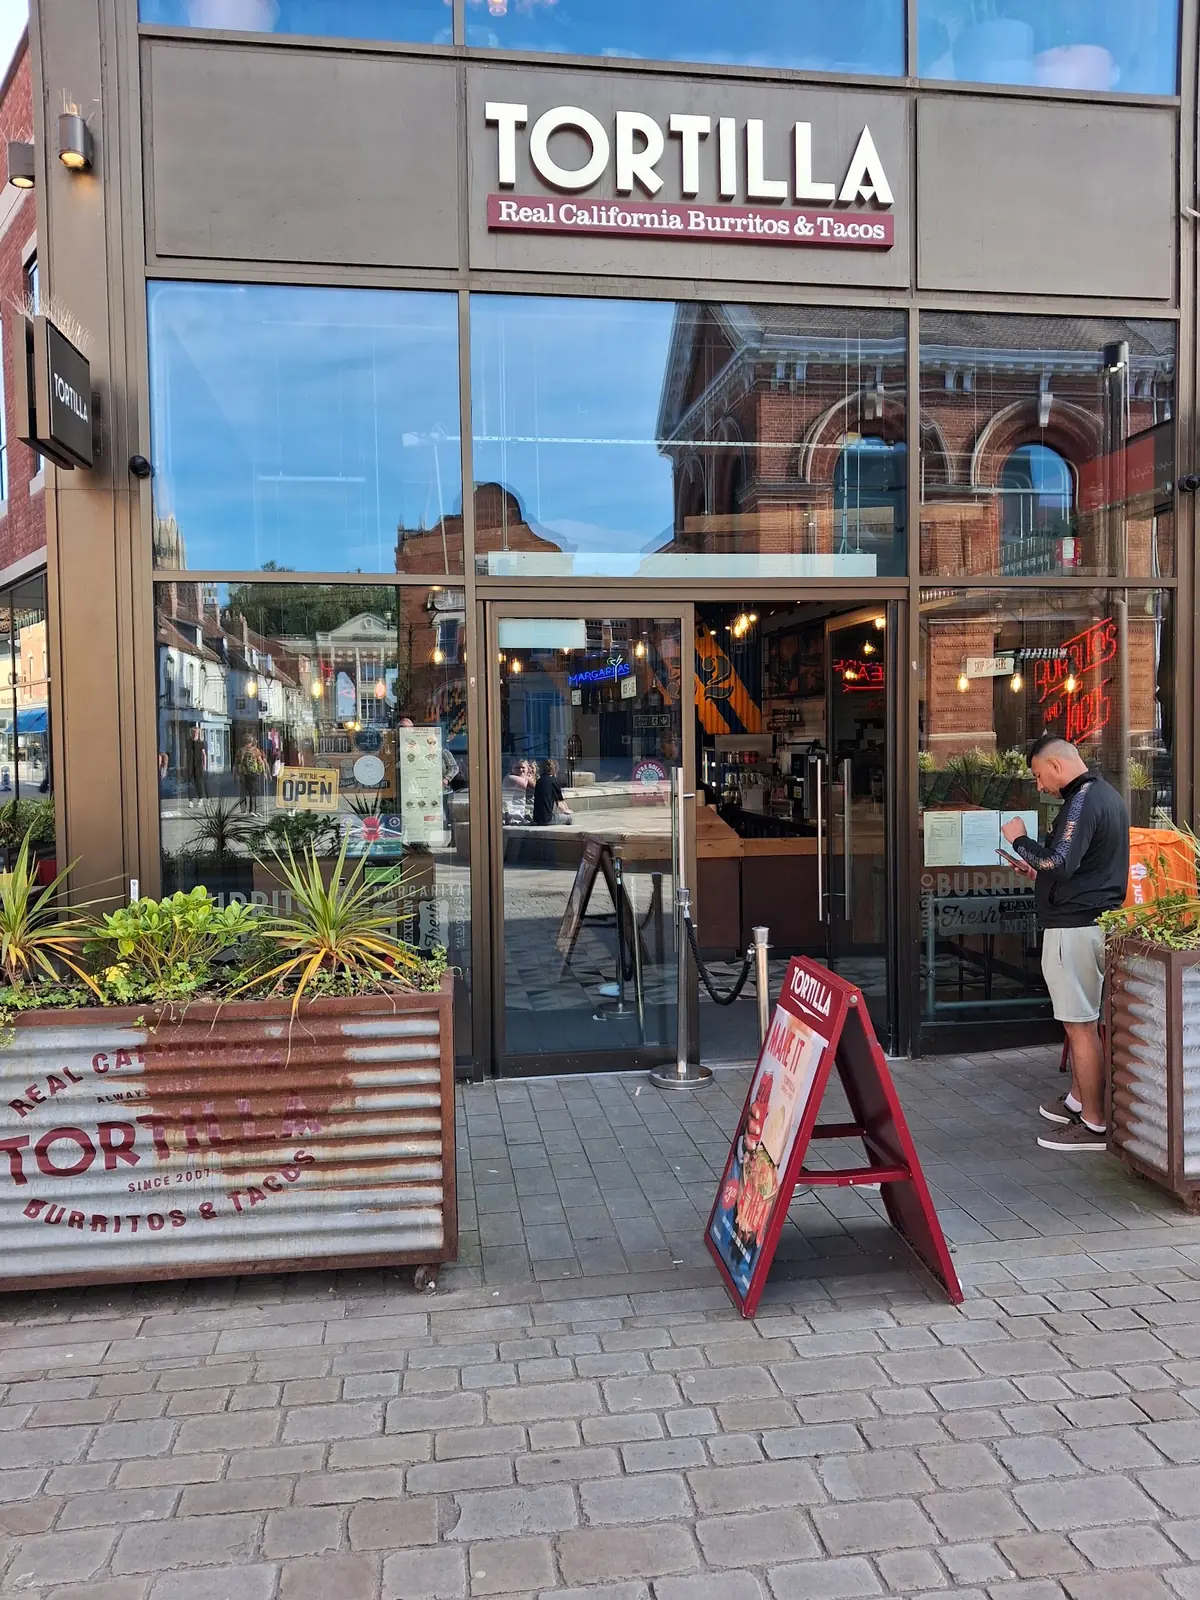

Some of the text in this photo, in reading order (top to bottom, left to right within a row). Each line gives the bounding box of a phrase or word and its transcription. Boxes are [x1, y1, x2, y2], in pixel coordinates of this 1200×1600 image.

[485, 101, 895, 206] TORTILLA
[498, 201, 886, 240] Real California Burritos & Tacos
[53, 372, 89, 423] TORTILLA
[282, 779, 333, 804] OPEN
[298, 772, 318, 780] WE'RE
[937, 871, 1036, 897] BURRIT
[1132, 883, 1144, 905] JUS
[424, 902, 442, 947] Fresh
[940, 905, 998, 928] Fresh
[790, 966, 833, 1017] TORTILLA
[767, 1020, 806, 1075] MAKE IT
[8, 1066, 84, 1118] REAL
[0, 1091, 322, 1186] TORTILLA
[22, 1149, 316, 1234] BURRITOS & TACOS
[128, 1168, 211, 1193] SINCE 2007
